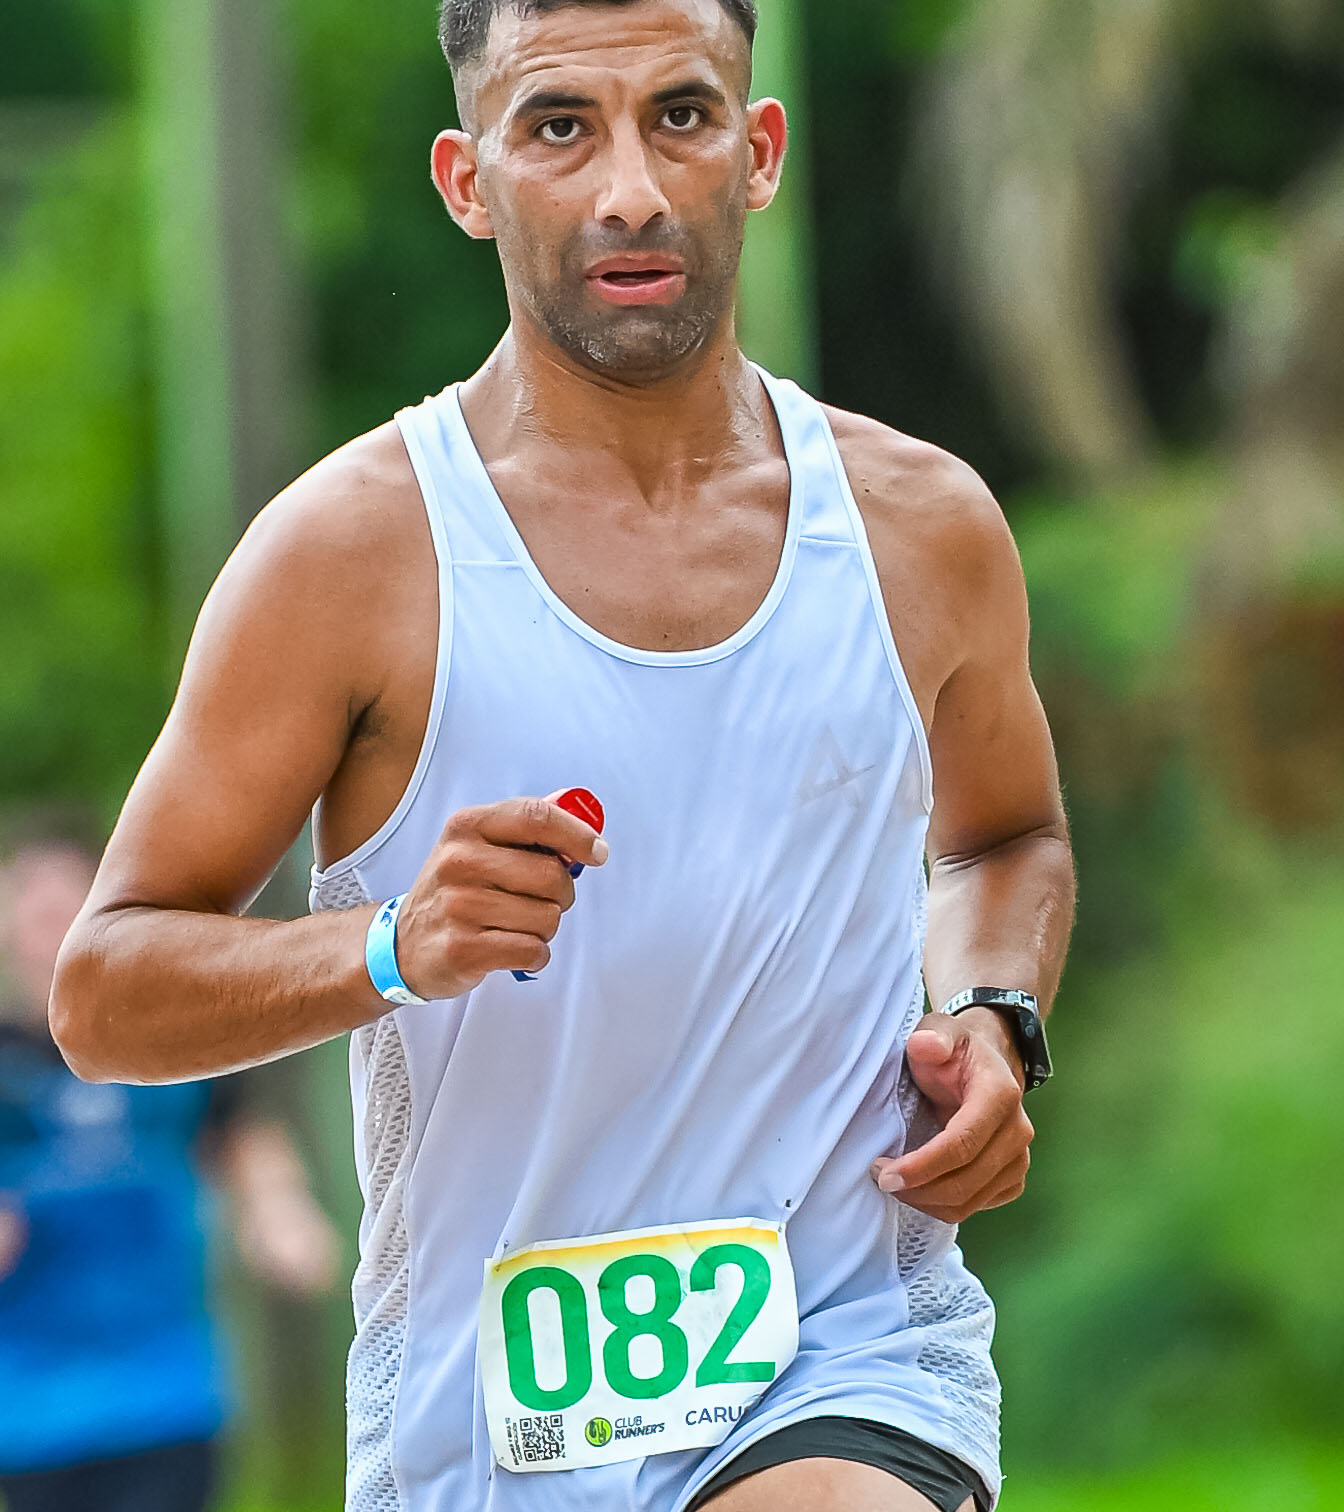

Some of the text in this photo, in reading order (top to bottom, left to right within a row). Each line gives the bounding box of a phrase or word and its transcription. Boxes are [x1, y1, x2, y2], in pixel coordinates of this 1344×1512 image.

[501, 1244, 776, 1411] 082
[614, 1415, 643, 1429] CLUB
[685, 1405, 745, 1426] CARU
